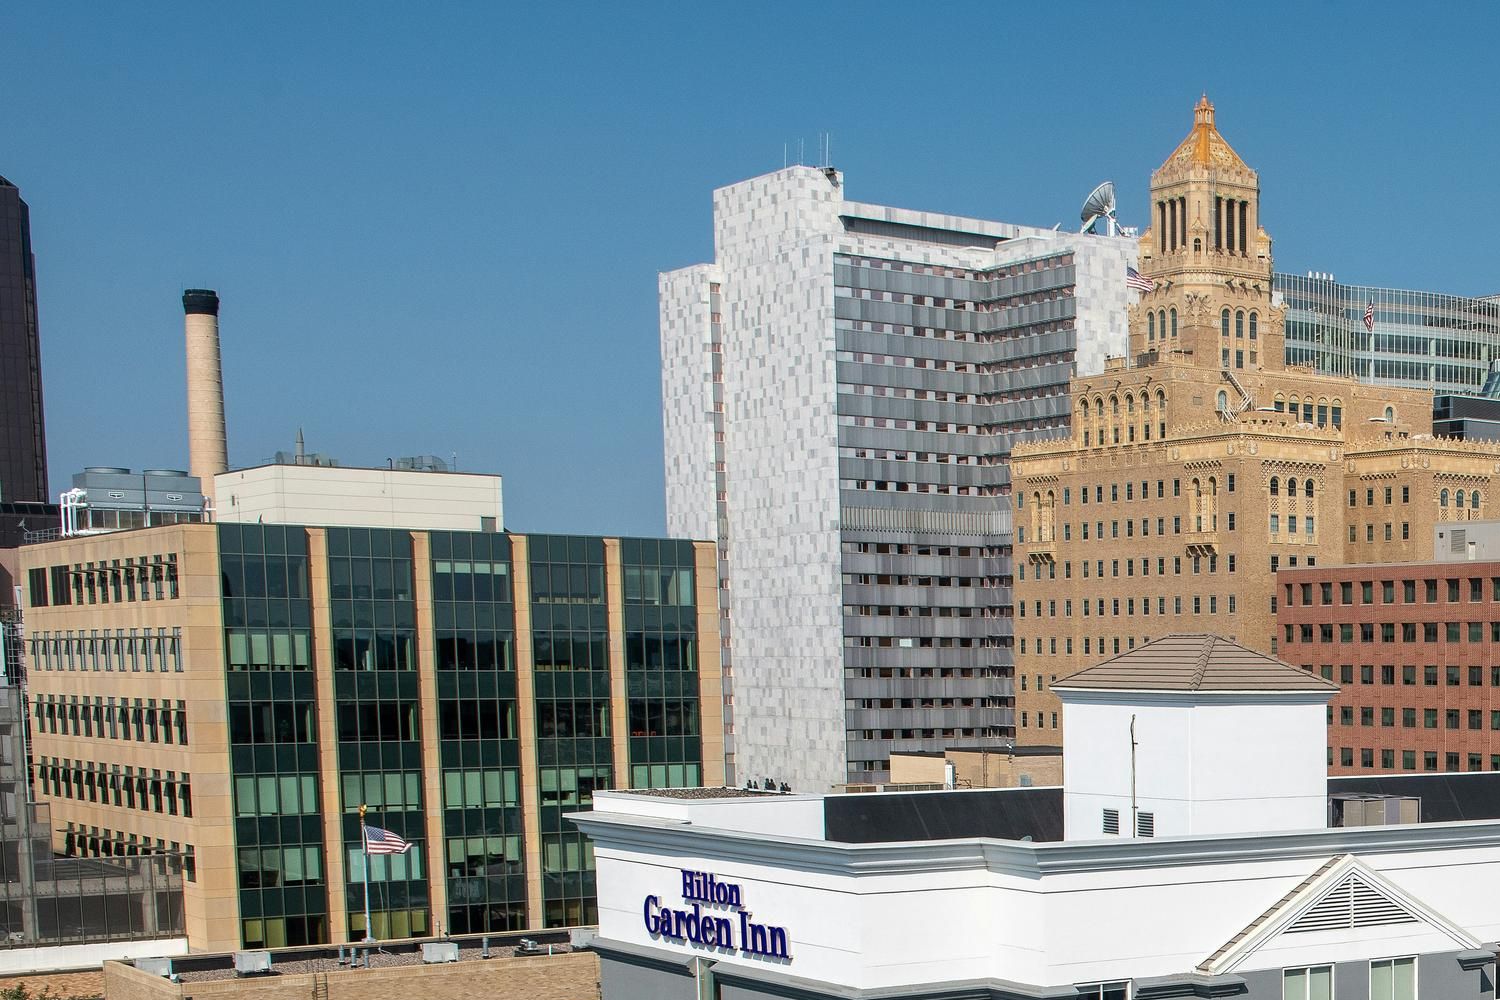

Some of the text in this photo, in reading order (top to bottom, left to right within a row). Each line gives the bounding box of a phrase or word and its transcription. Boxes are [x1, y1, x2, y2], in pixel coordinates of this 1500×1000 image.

[681, 869, 743, 907] Hilton
[644, 895, 792, 959] Garden Inn
